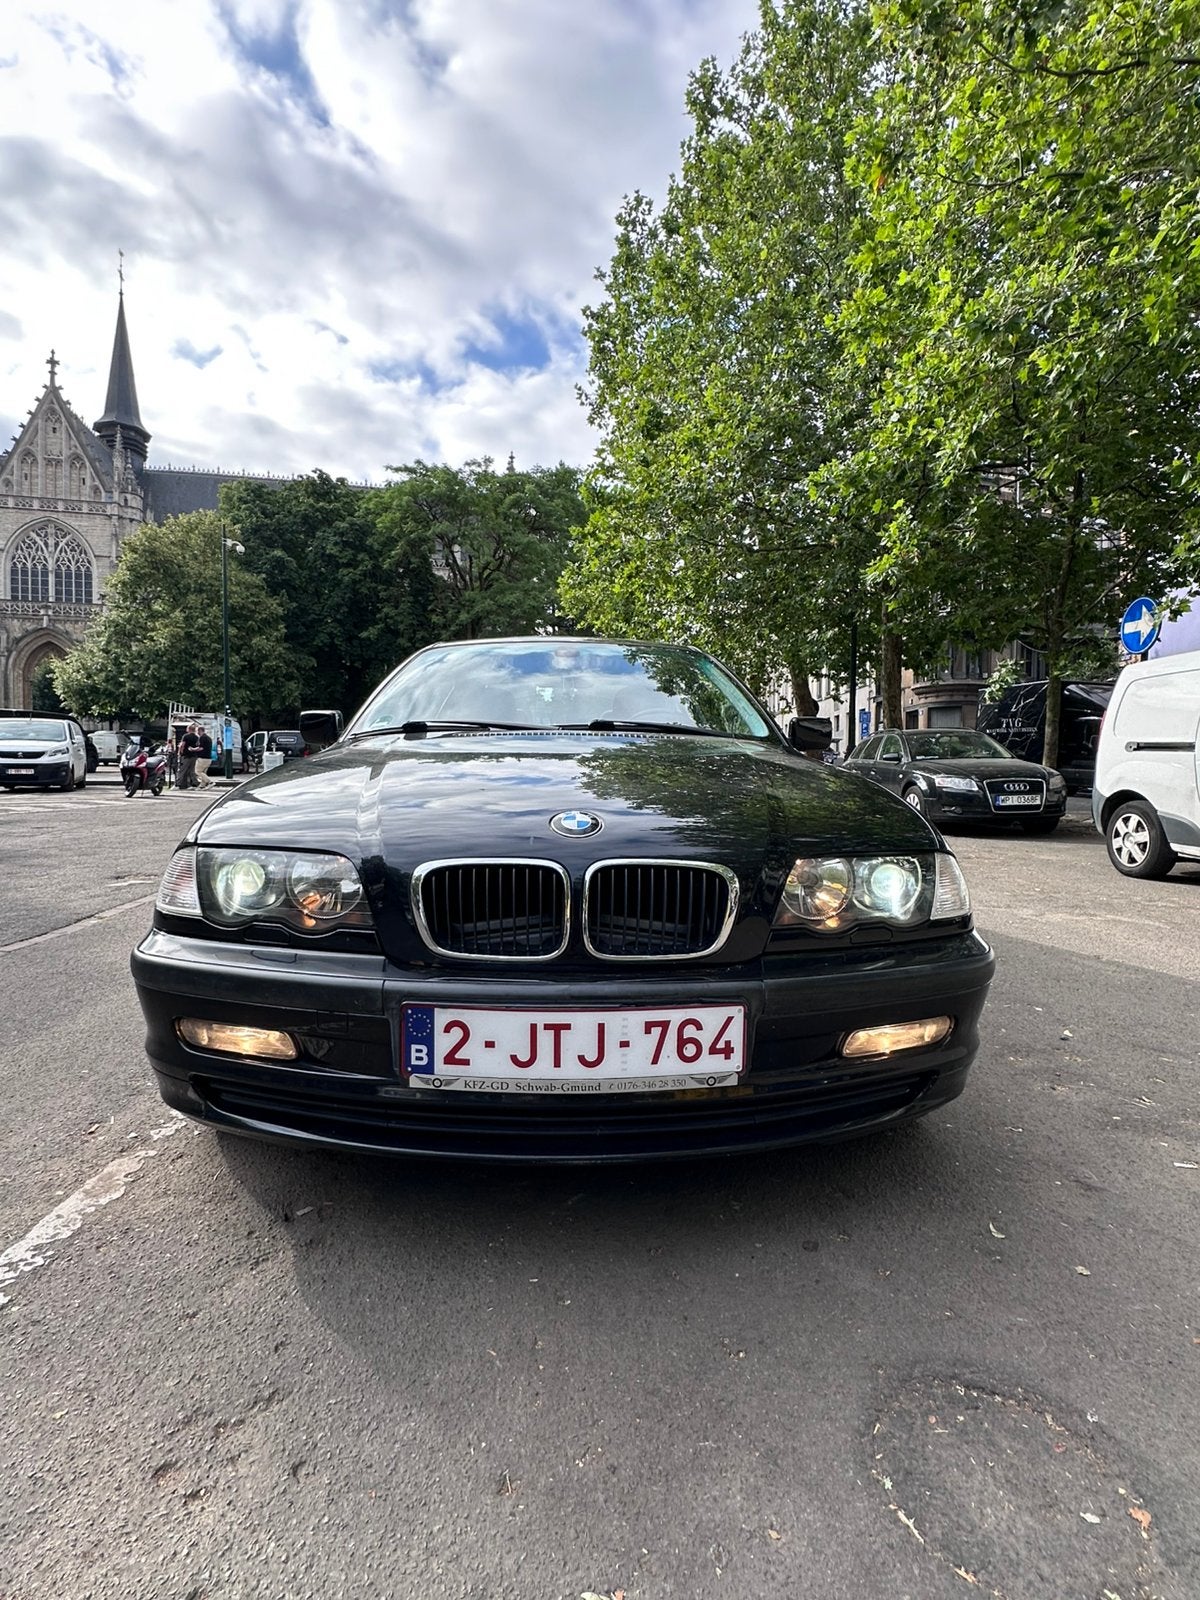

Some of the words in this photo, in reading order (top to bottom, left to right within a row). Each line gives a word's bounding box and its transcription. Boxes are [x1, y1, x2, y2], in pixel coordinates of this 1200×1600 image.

[442, 1016, 735, 1069] 2-JTJ-764
[411, 1044, 428, 1065] B
[464, 1080, 509, 1091] KFZ-GD
[515, 1080, 601, 1093] Schwab-Gmünd
[658, 1080, 668, 1088] 28
[670, 1079, 687, 1088] 350
